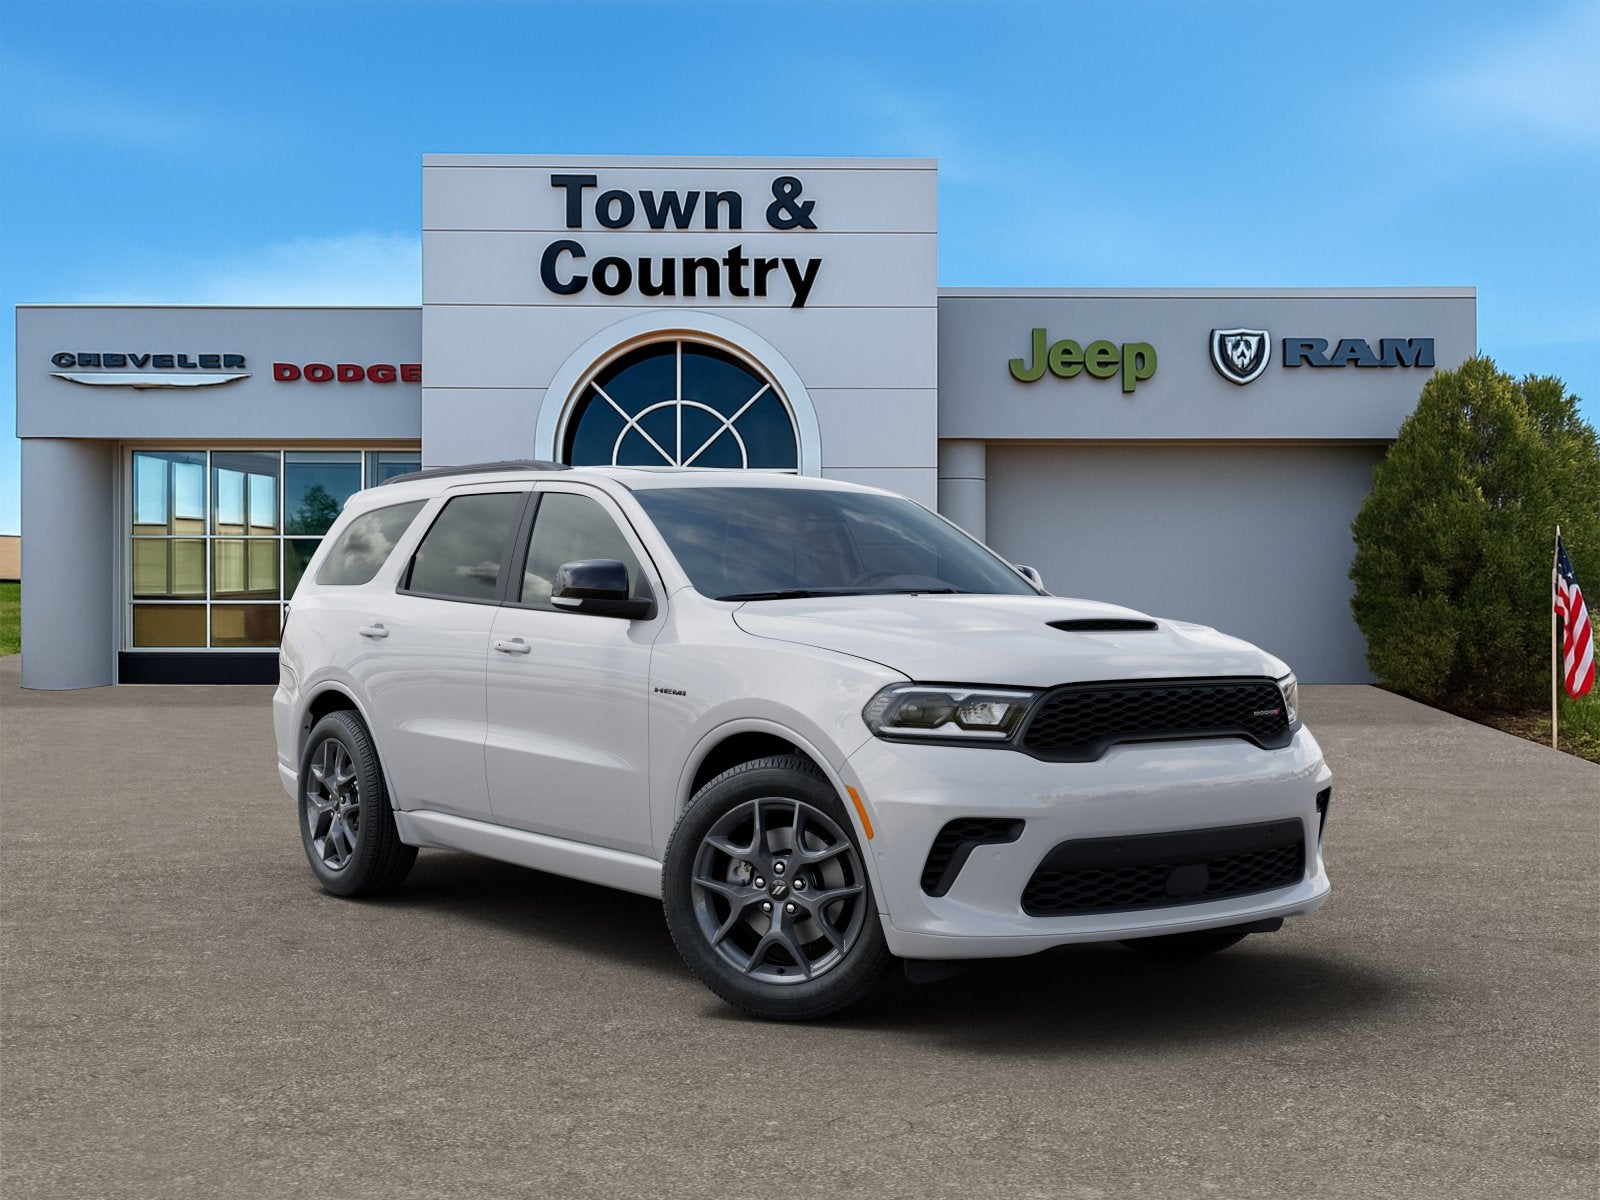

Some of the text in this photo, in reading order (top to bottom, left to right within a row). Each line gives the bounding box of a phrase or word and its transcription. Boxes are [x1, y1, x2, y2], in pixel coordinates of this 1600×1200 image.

[550, 174, 818, 230] Town &
[540, 239, 822, 308] Country
[272, 363, 422, 383] DODGE
[1009, 328, 1158, 393] Jeep
[1282, 337, 1436, 367] RAM
[654, 687, 687, 697] HEMI
